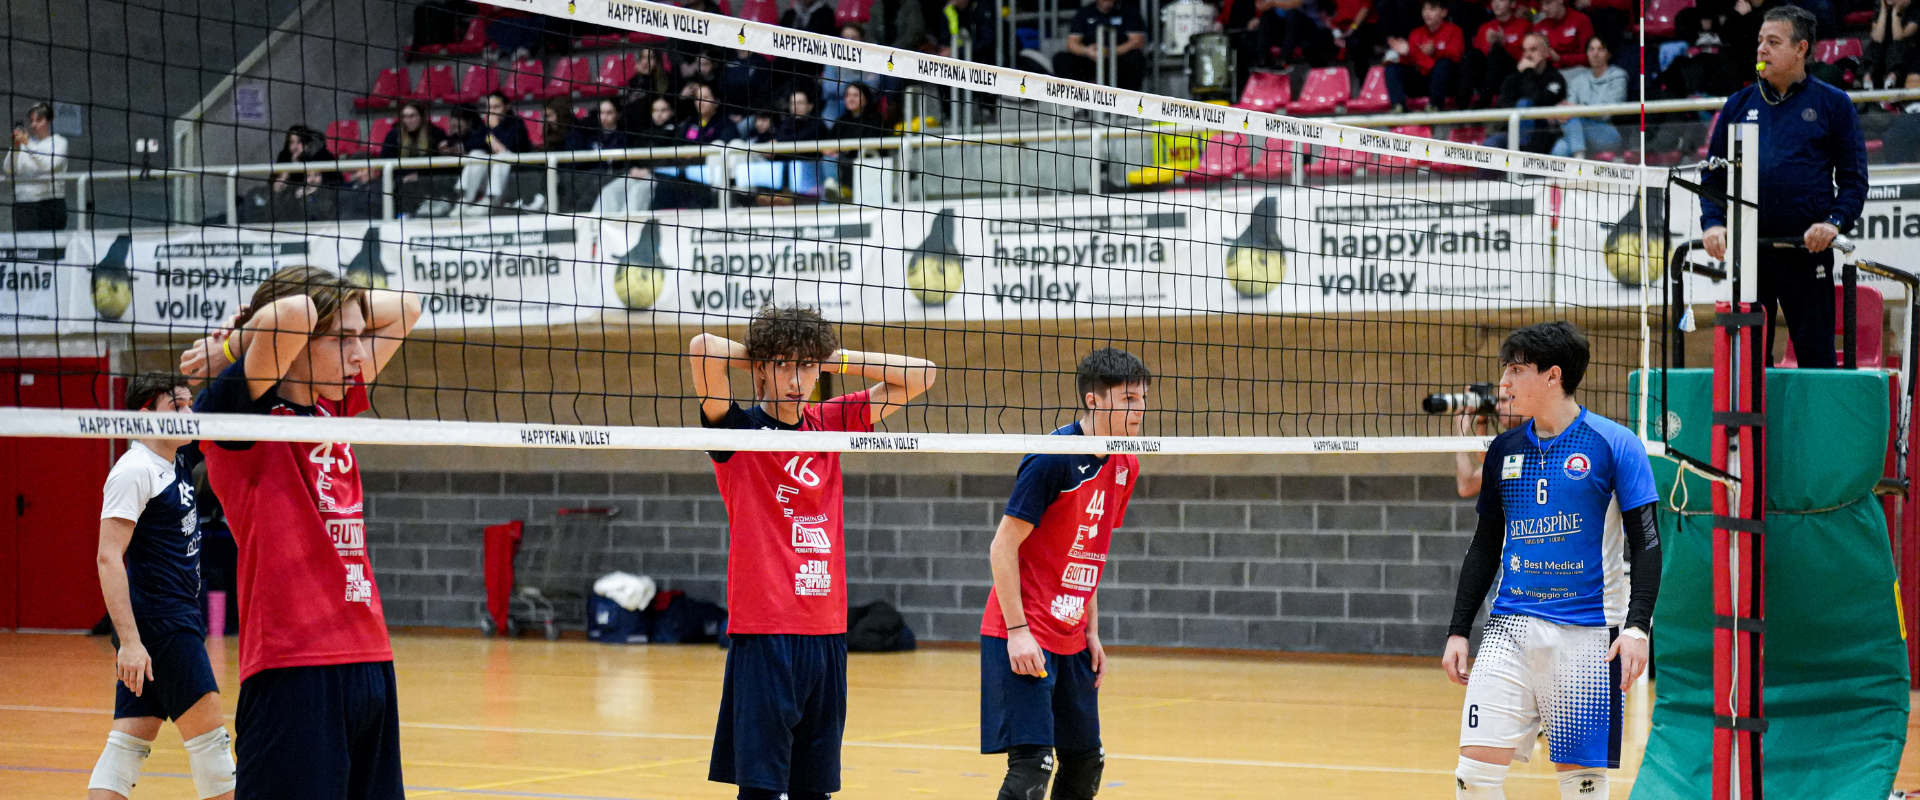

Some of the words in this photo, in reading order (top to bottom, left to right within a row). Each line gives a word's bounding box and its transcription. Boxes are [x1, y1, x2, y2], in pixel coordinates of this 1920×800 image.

[672, 14, 710, 36] VOLLEY
[830, 43, 863, 63] VOLLEY
[968, 68, 997, 87] VOLLEY
[1093, 90, 1117, 108] VOLLEY
[1202, 108, 1226, 124] VOLLEY
[1867, 185, 1901, 199] imini
[992, 236, 1166, 268] happyfania
[1320, 223, 1512, 259] happyfania
[412, 250, 561, 283] happyfania
[692, 244, 853, 277] happyfania
[0, 264, 52, 290] fania
[1320, 265, 1417, 296] volley
[692, 282, 772, 309] volley
[992, 276, 1081, 305] volley
[156, 294, 226, 320] volley
[159, 418, 200, 435] VOLLEY
[578, 431, 611, 445] VOLLEY
[893, 437, 919, 450] VOLLEY
[309, 442, 353, 474] 43
[783, 455, 820, 487] 16
[1535, 477, 1549, 505] 6
[1085, 489, 1106, 521] 44
[795, 526, 827, 546] BUTTI
[808, 560, 829, 575] EDIL
[1065, 565, 1095, 584] BUTTI
[1524, 559, 1543, 570] Best
[1544, 559, 1584, 570] Medical
[1063, 594, 1085, 609] EDIL
[1525, 590, 1561, 600] Villaggio
[1468, 704, 1479, 728] 6
